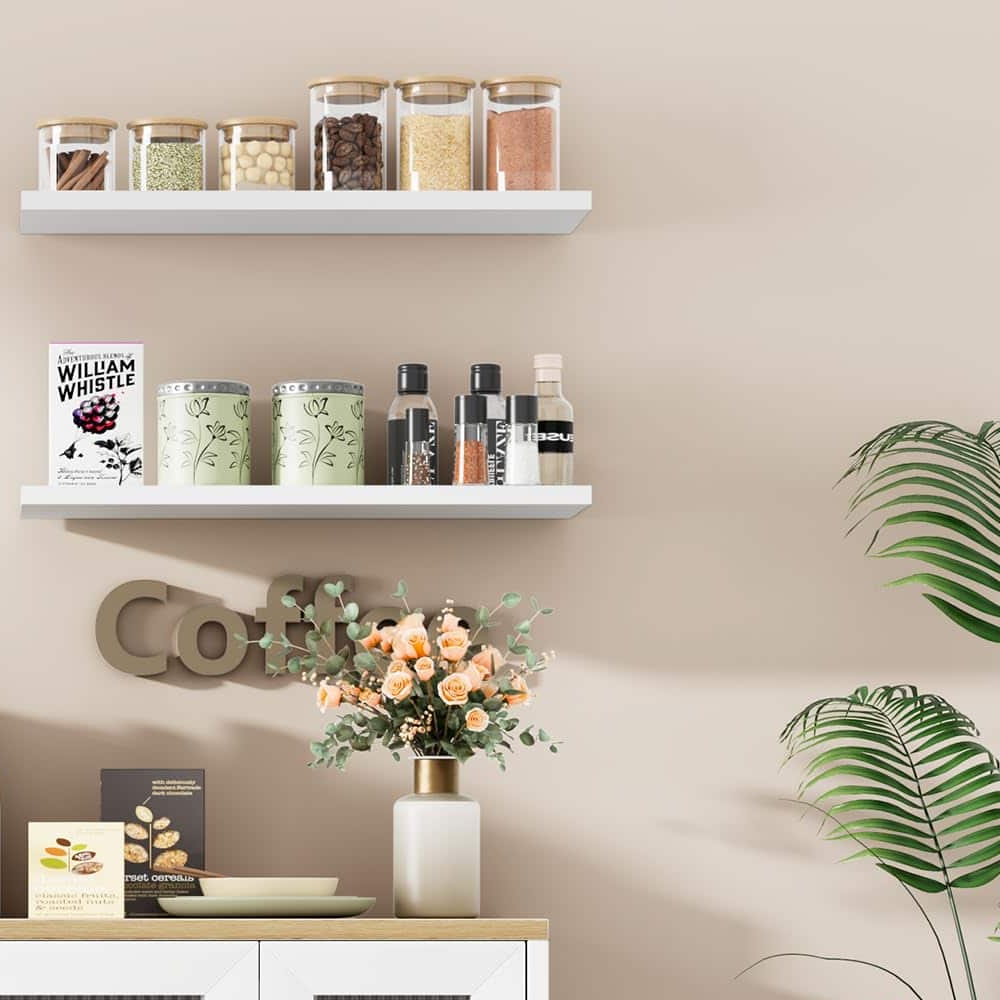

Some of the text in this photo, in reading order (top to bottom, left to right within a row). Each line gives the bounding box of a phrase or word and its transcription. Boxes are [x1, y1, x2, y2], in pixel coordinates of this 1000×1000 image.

[57, 359, 135, 383] WILLIAM
[57, 373, 135, 402] WHISTLE
[124, 873, 149, 882] rset
